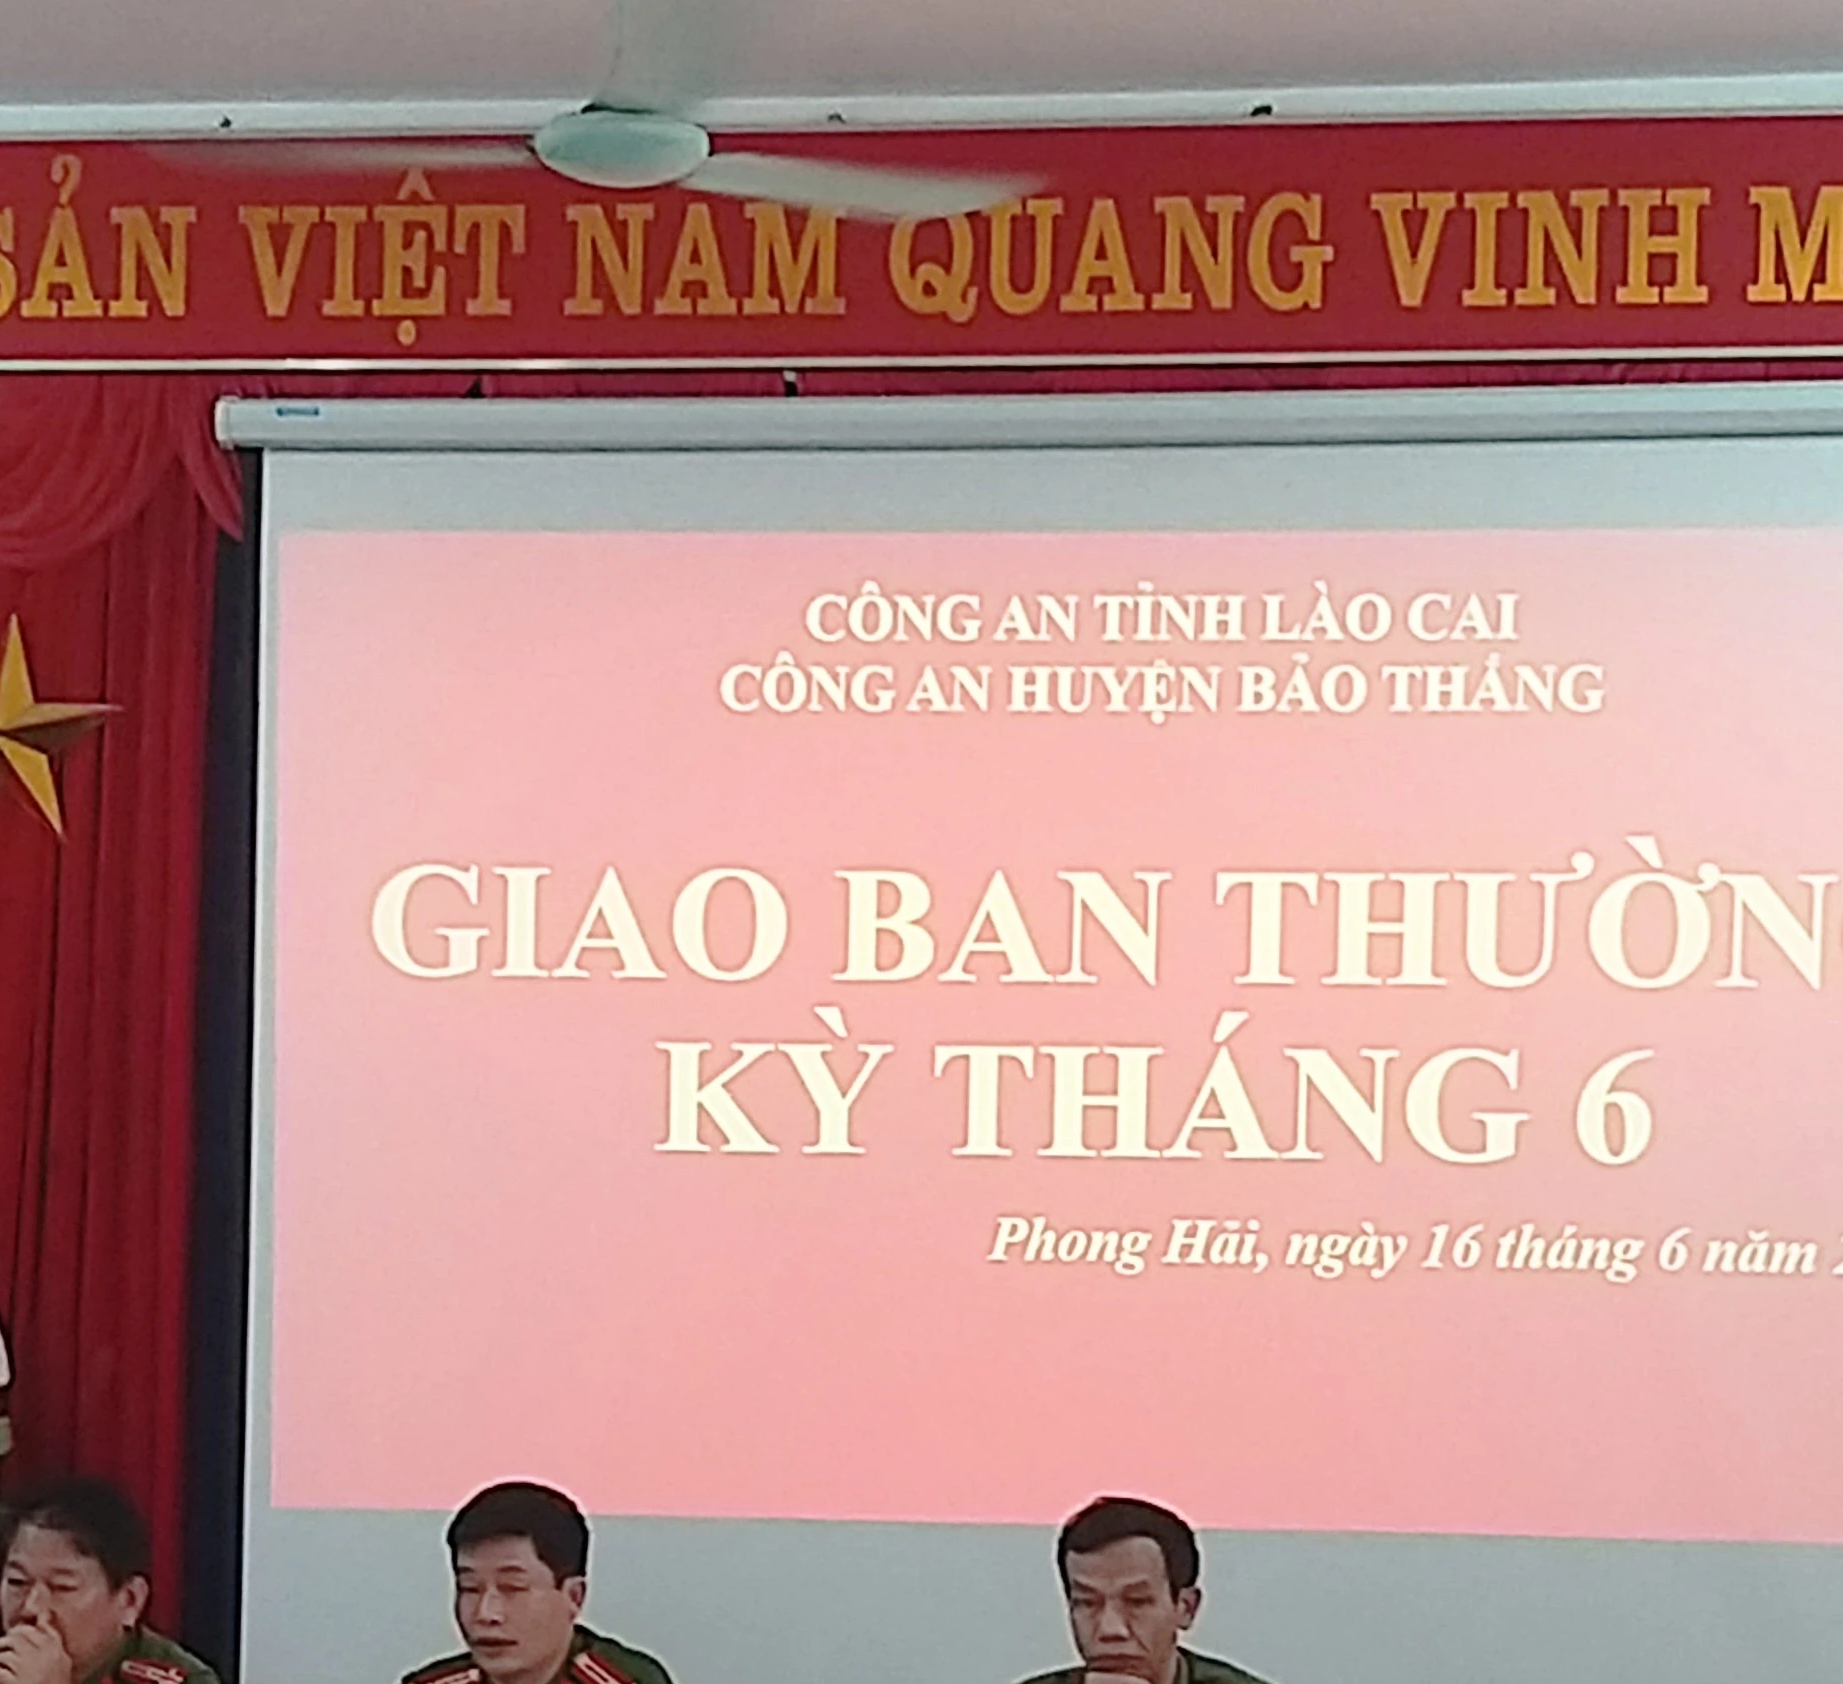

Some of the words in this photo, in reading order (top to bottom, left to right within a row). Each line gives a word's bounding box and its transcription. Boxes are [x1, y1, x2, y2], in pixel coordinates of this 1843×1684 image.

[241, 168, 523, 344] VIỆT
[564, 202, 847, 315] NAM
[889, 193, 1334, 323] QUANG
[1371, 188, 1707, 306] VINH
[807, 581, 981, 641] CÔNG
[994, 596, 1078, 640] AN
[1094, 582, 1245, 640] TỈNH
[1262, 581, 1391, 640] LÀO
[1409, 594, 1518, 640] CAI
[721, 652, 895, 712] CÔNG
[907, 666, 991, 711] AN
[1009, 660, 1221, 723] HUYỆN
[1239, 653, 1366, 712] BẢO
[373, 865, 786, 980] GIAO
[834, 868, 1172, 986] BAN
[655, 1007, 893, 1152] KỲ
[935, 1012, 1529, 1162] THÁNG
[1578, 1050, 1653, 1163] 6
[988, 1217, 1152, 1274] Phong
[1286, 1222, 1407, 1278] ngày
[1422, 1224, 1483, 1267] 16
[1497, 1224, 1644, 1282] tháng
[1660, 1228, 1690, 1270] 6
[1704, 1231, 1817, 1273] năm
